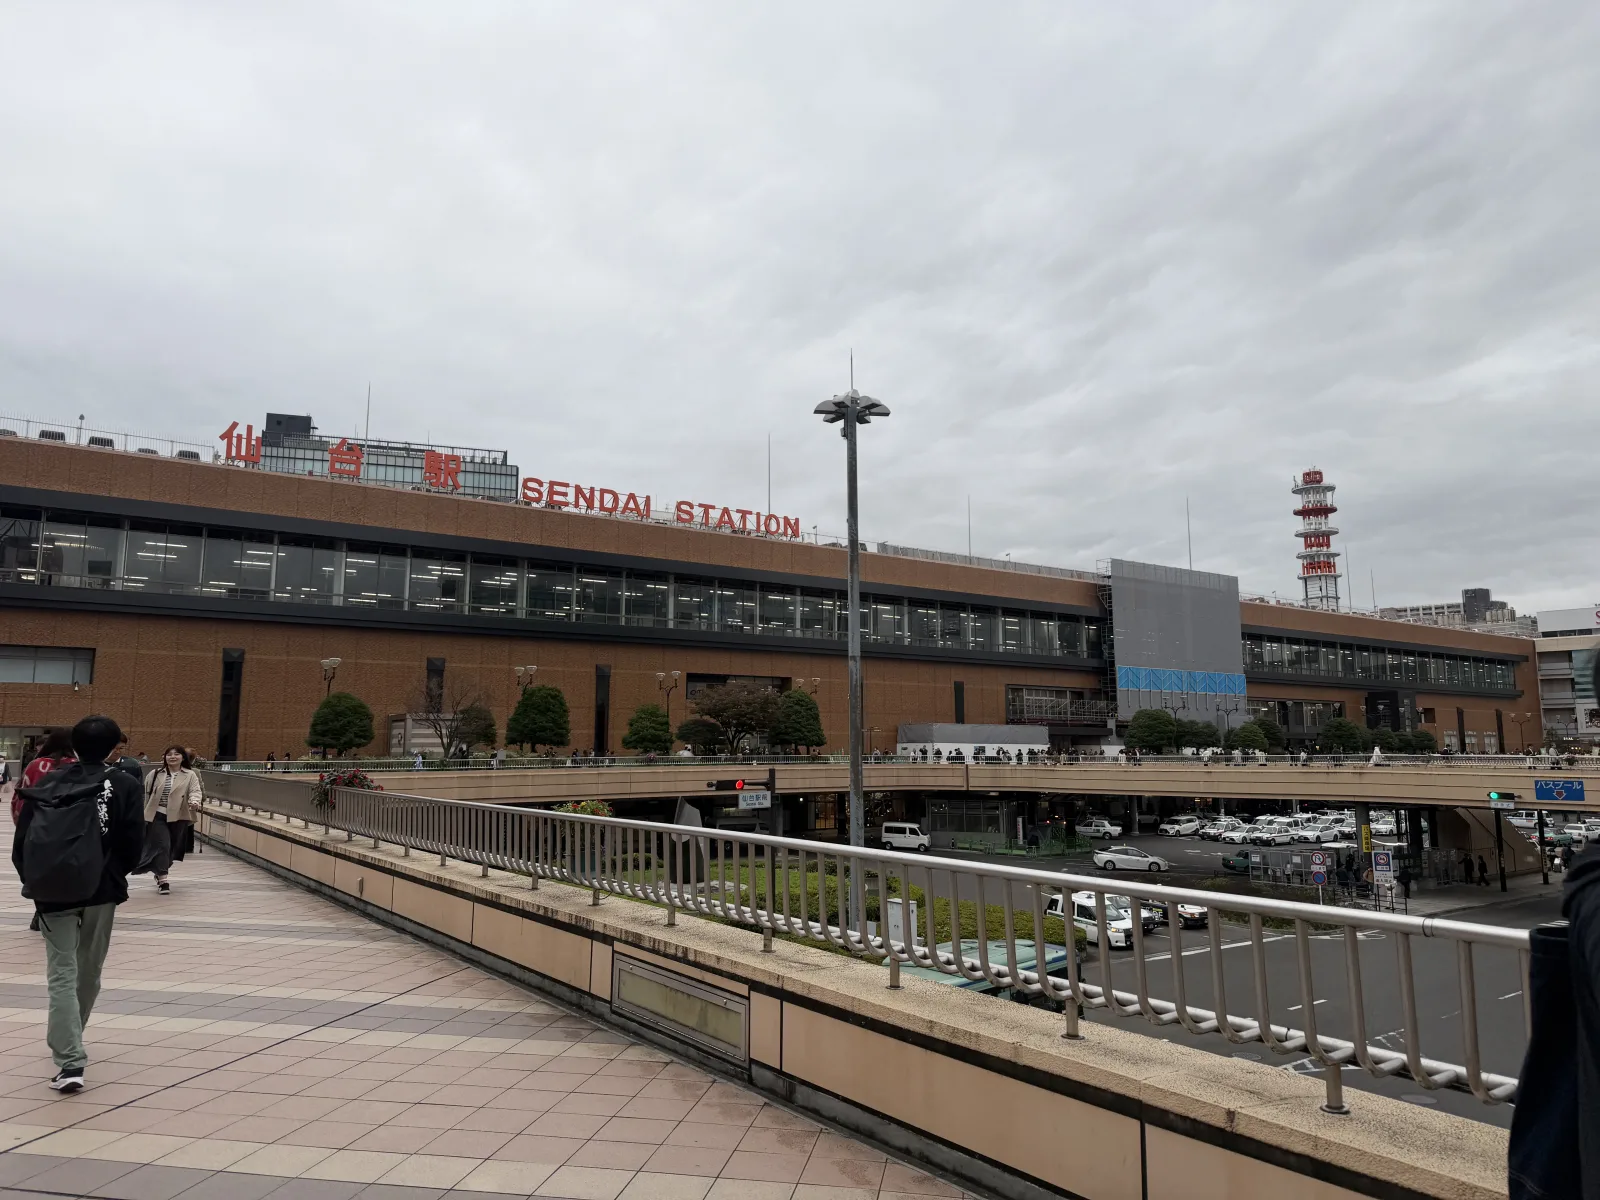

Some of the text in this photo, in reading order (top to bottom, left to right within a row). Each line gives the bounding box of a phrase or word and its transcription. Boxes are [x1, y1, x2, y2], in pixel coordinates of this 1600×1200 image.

[219, 421, 462, 490] 仙台駅
[522, 477, 800, 537] SENDAI STATION
[1536, 780, 1582, 789] バスプール
